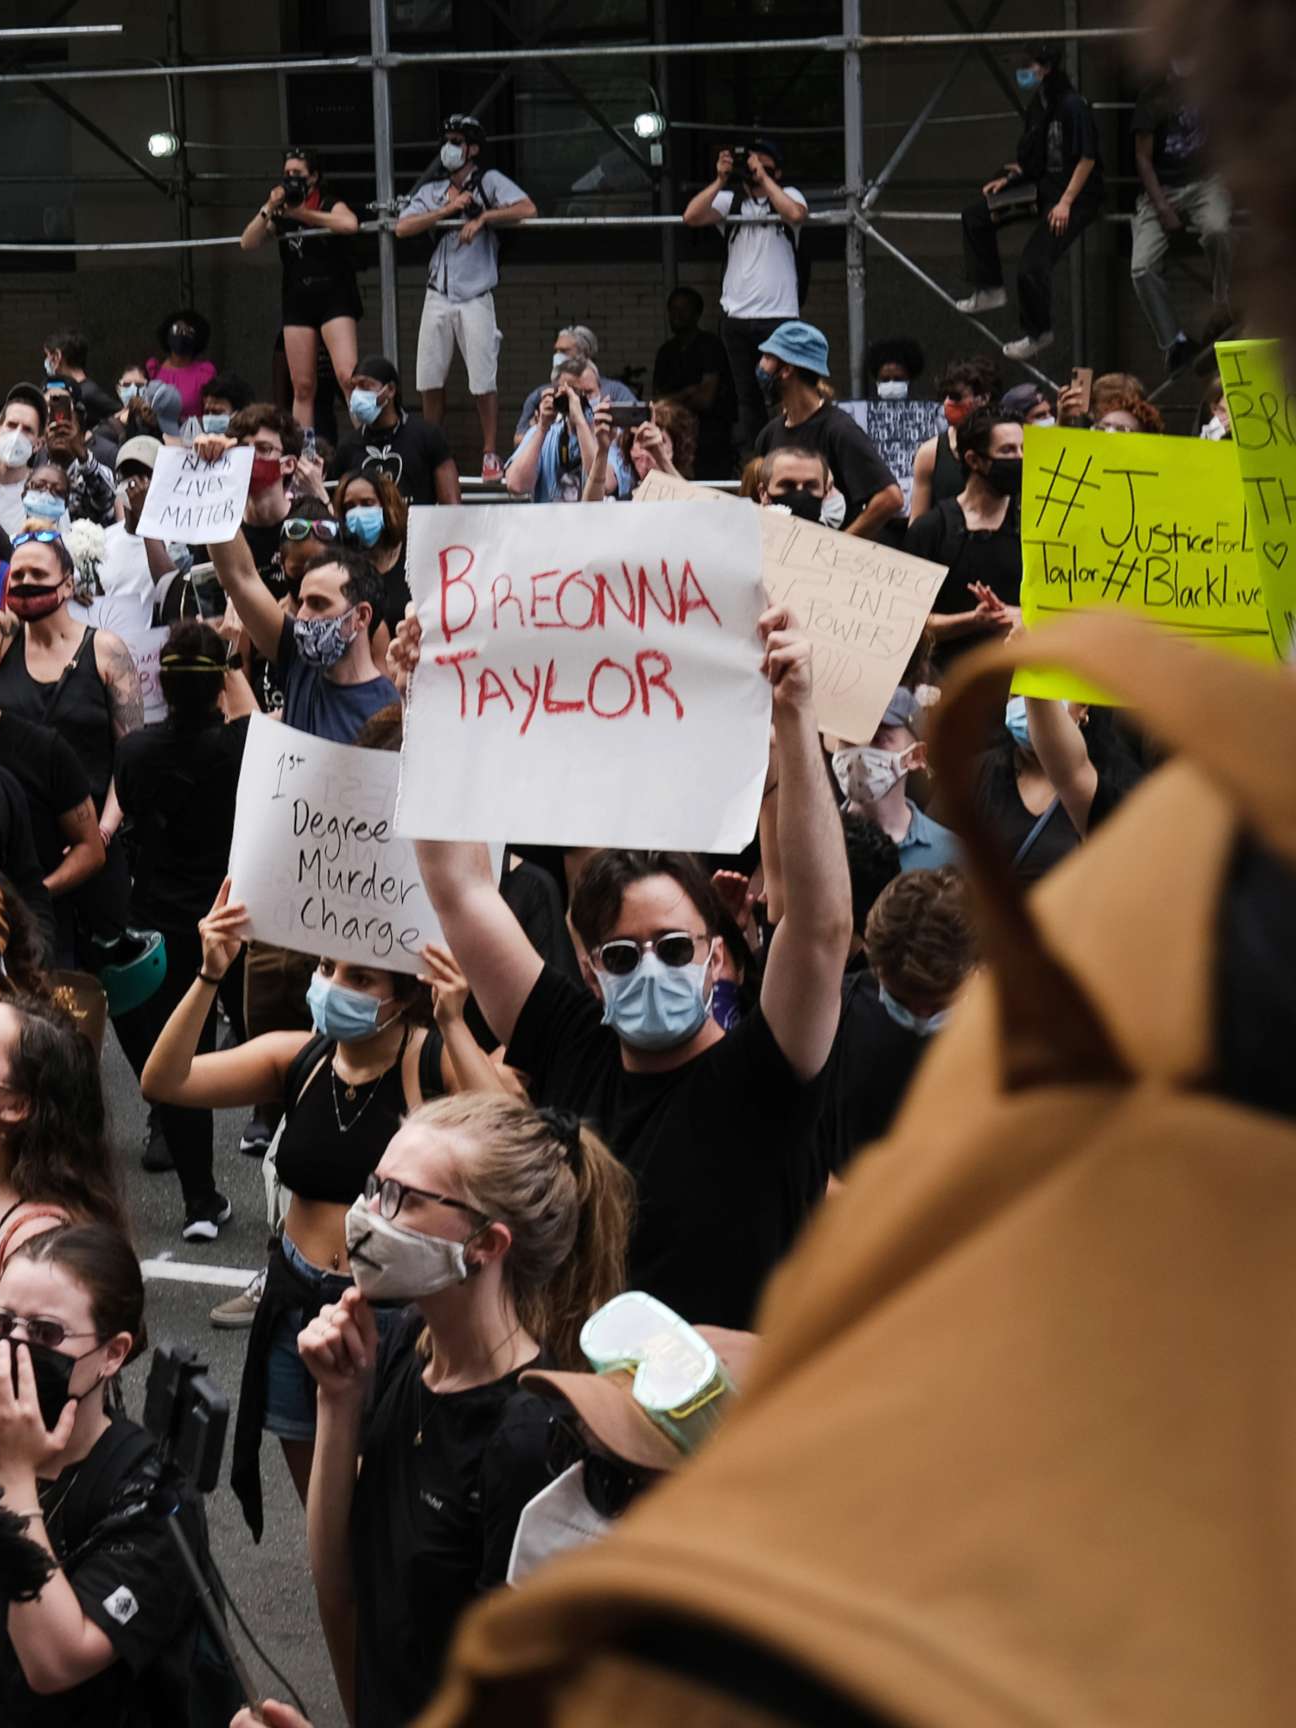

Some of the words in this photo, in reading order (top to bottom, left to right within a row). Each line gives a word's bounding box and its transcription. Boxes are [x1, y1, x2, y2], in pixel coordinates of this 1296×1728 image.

[159, 499, 235, 530] MATTER
[172, 475, 224, 498] LIVES
[438, 545, 722, 643] BREONNA
[434, 649, 684, 736] TAYLOR
[292, 798, 391, 863] Degree
[297, 848, 420, 905] Murder
[300, 896, 422, 958] Charge
